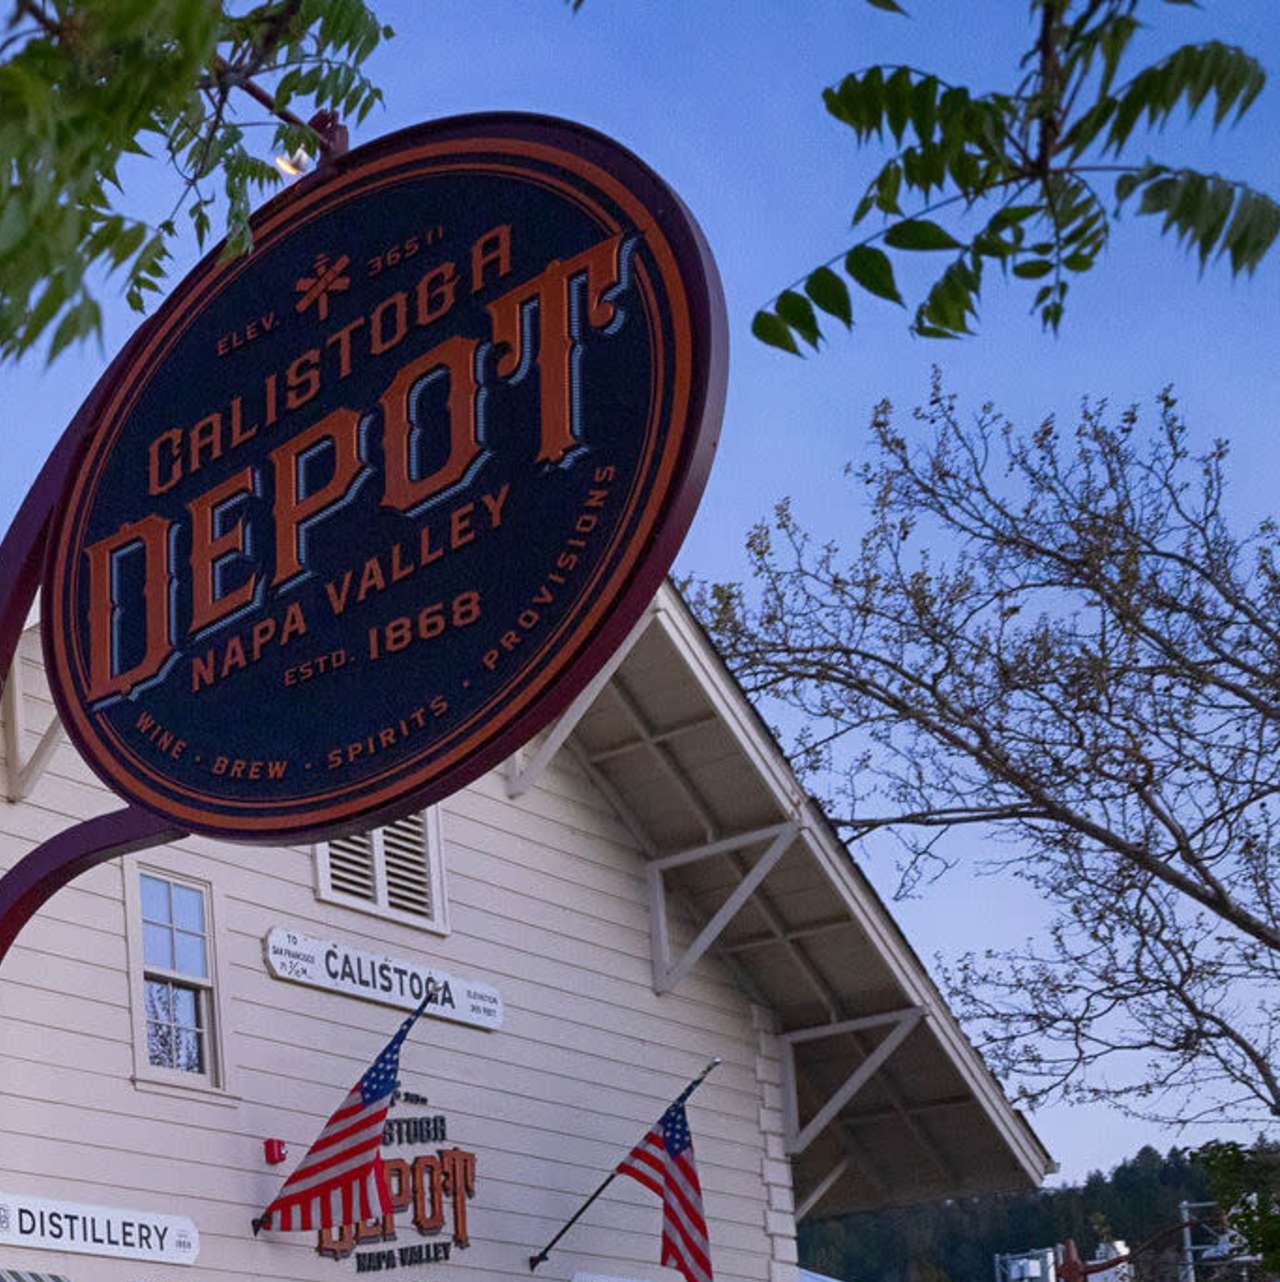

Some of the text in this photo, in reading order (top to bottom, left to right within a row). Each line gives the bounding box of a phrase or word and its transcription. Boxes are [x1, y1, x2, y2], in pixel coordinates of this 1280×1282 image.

[147, 224, 513, 496] CALISTOGA
[83, 233, 636, 710] DEPOT
[136, 465, 615, 780] WINE BREW SPIRITS PROVISIONS
[191, 484, 512, 692] NAPA VALLEY
[367, 591, 482, 662] 1868
[325, 949, 456, 1010] CALISTOGA
[17, 1207, 169, 1251] DISTILLERY
[355, 1242, 452, 1273] NAPA VALLEY
